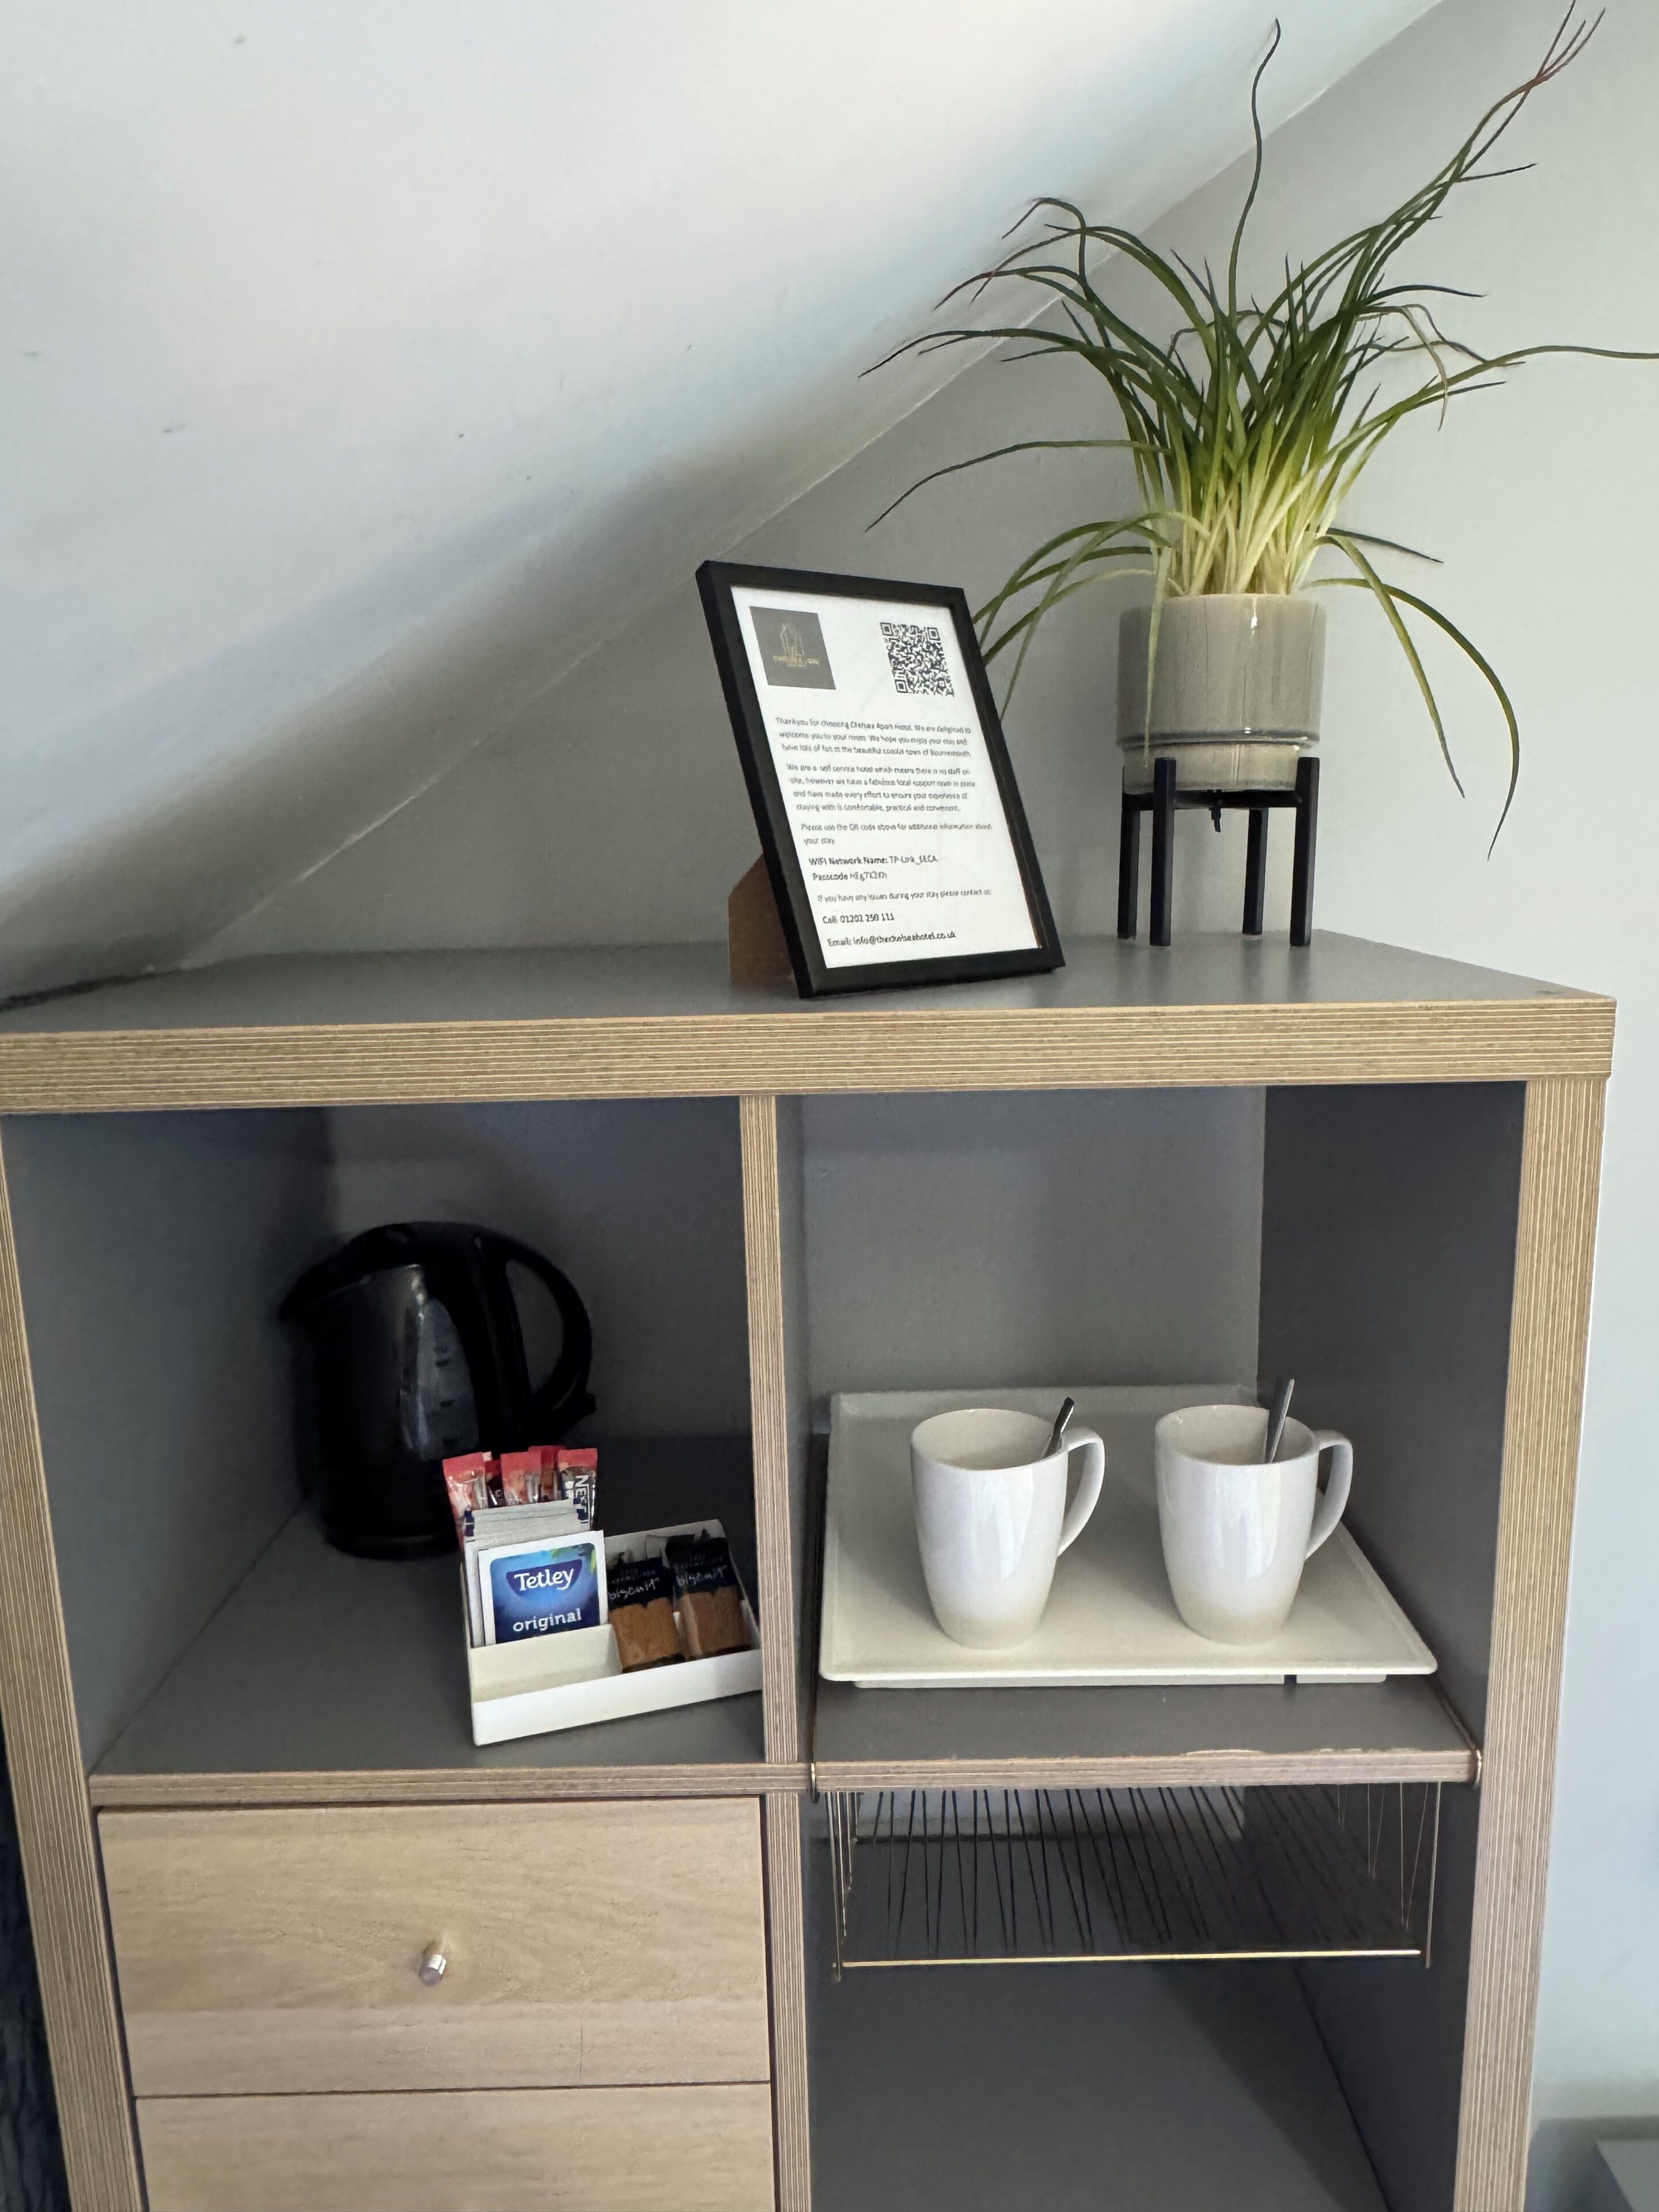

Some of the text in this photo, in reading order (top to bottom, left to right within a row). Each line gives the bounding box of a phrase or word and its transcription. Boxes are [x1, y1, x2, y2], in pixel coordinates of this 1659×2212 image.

[840, 914, 863, 923] 01202
[881, 912, 895, 922] 111
[513, 1567, 574, 1591] Tetley
[513, 1608, 582, 1632] original
